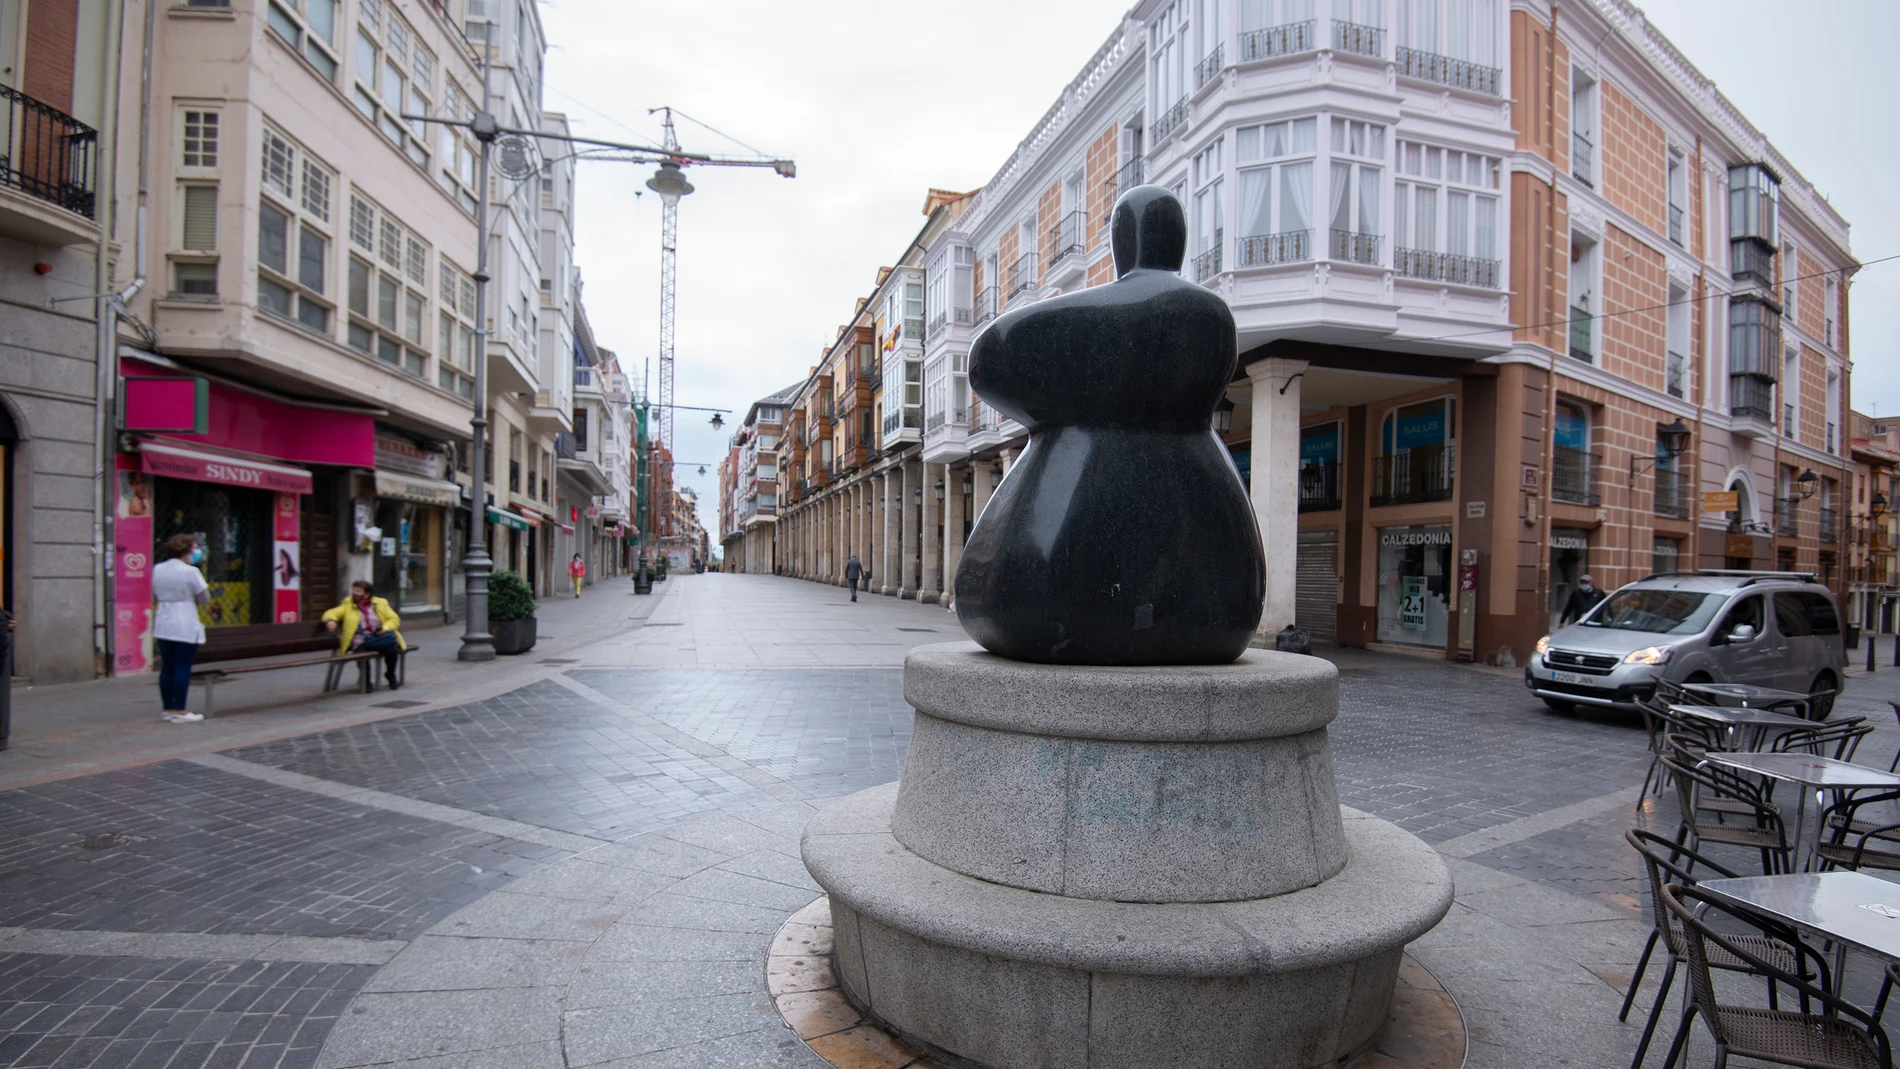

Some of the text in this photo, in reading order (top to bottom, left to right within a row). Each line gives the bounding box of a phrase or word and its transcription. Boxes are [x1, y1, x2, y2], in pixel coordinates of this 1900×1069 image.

[1403, 421, 1439, 435] SALUS
[1305, 440, 1334, 453] SALUS
[206, 464, 263, 484] SINDY
[1382, 532, 1451, 546] CALZEDONIA
[1549, 536, 1588, 549] ALZEDONIA
[1409, 585, 1420, 593] MIX
[1403, 595, 1424, 613] 2+1
[1403, 614, 1424, 625] GRATIS
